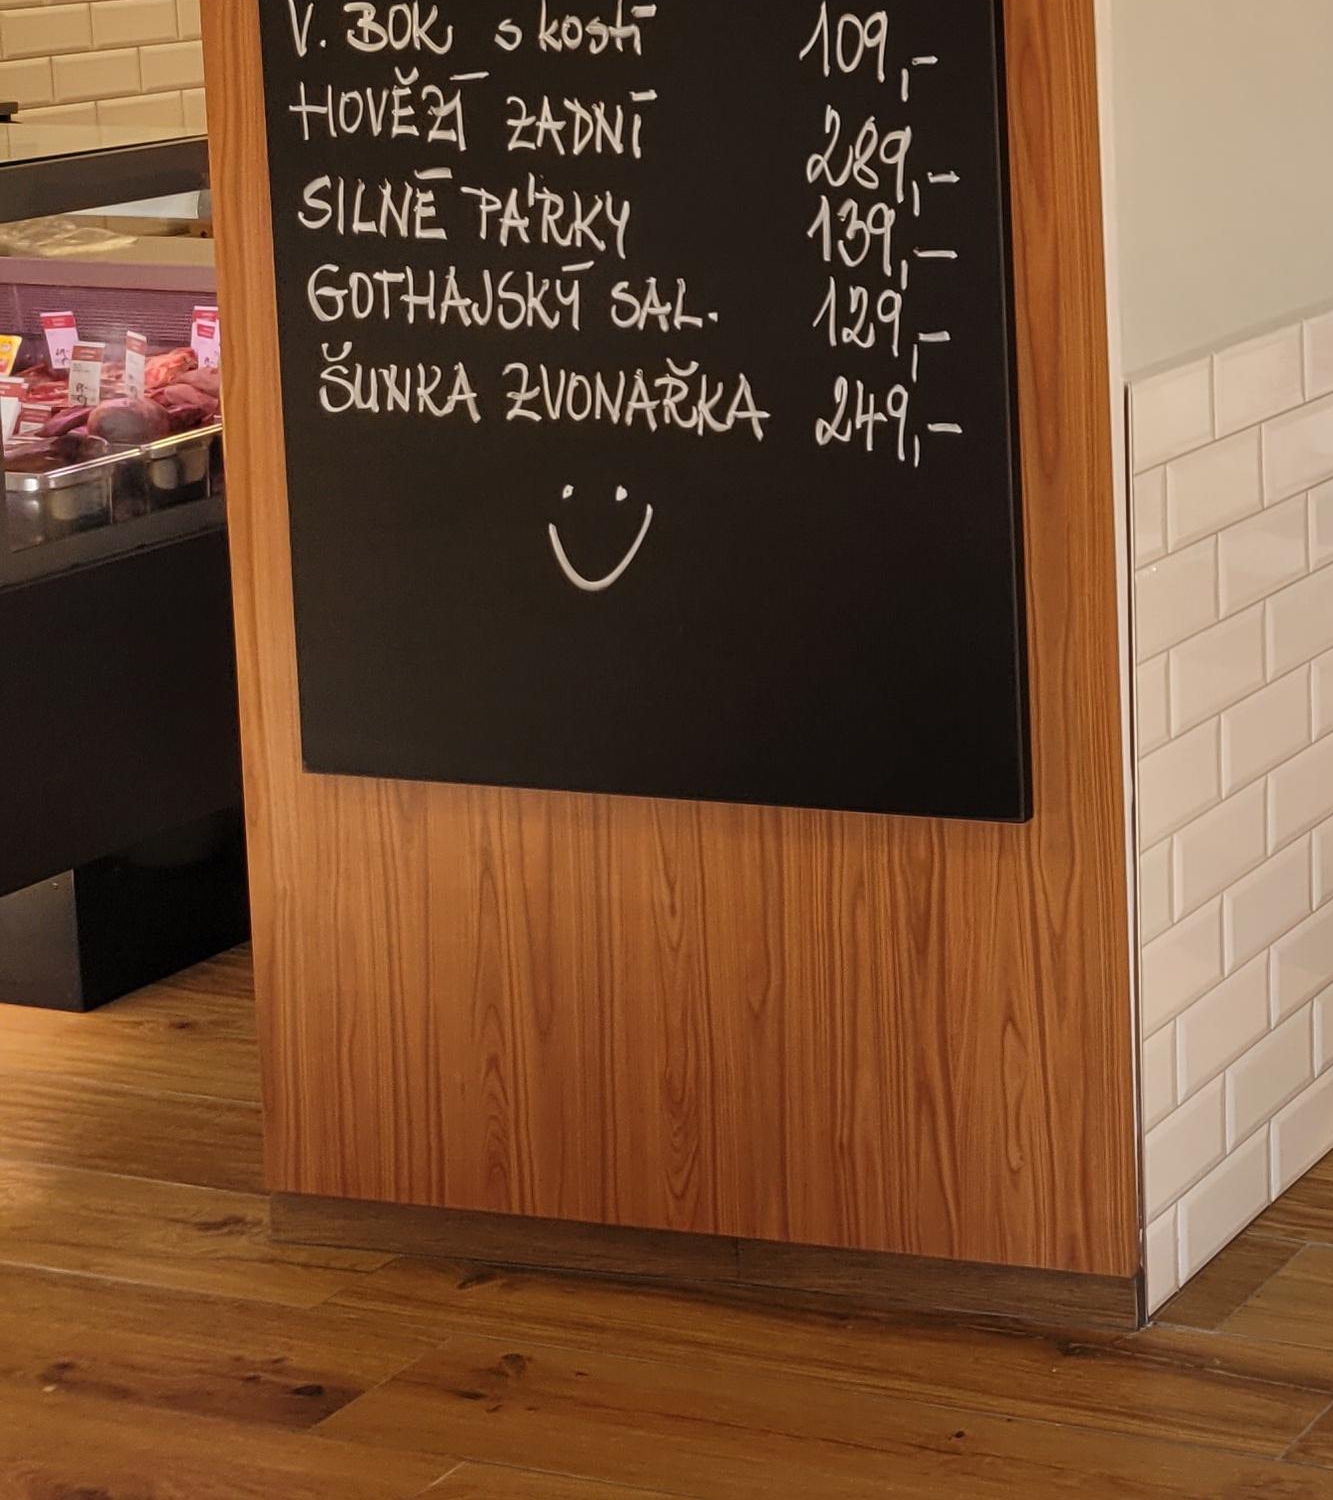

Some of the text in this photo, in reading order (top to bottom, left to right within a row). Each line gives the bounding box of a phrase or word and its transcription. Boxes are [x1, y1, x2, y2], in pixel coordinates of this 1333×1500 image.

[343, 0, 453, 55] BOK
[495, 17, 523, 51] s
[289, 66, 490, 152] HOVĚZÍ
[507, 90, 659, 160] ZADNÍ
[297, 167, 453, 240] SILNÉ
[461, 172, 632, 260] PÁRKY
[307, 260, 595, 331] GOTHAJSKÝ
[610, 276, 719, 333] SAL.
[318, 340, 482, 424] ŠUNKA
[502, 357, 771, 442] ZVONAŘKA
